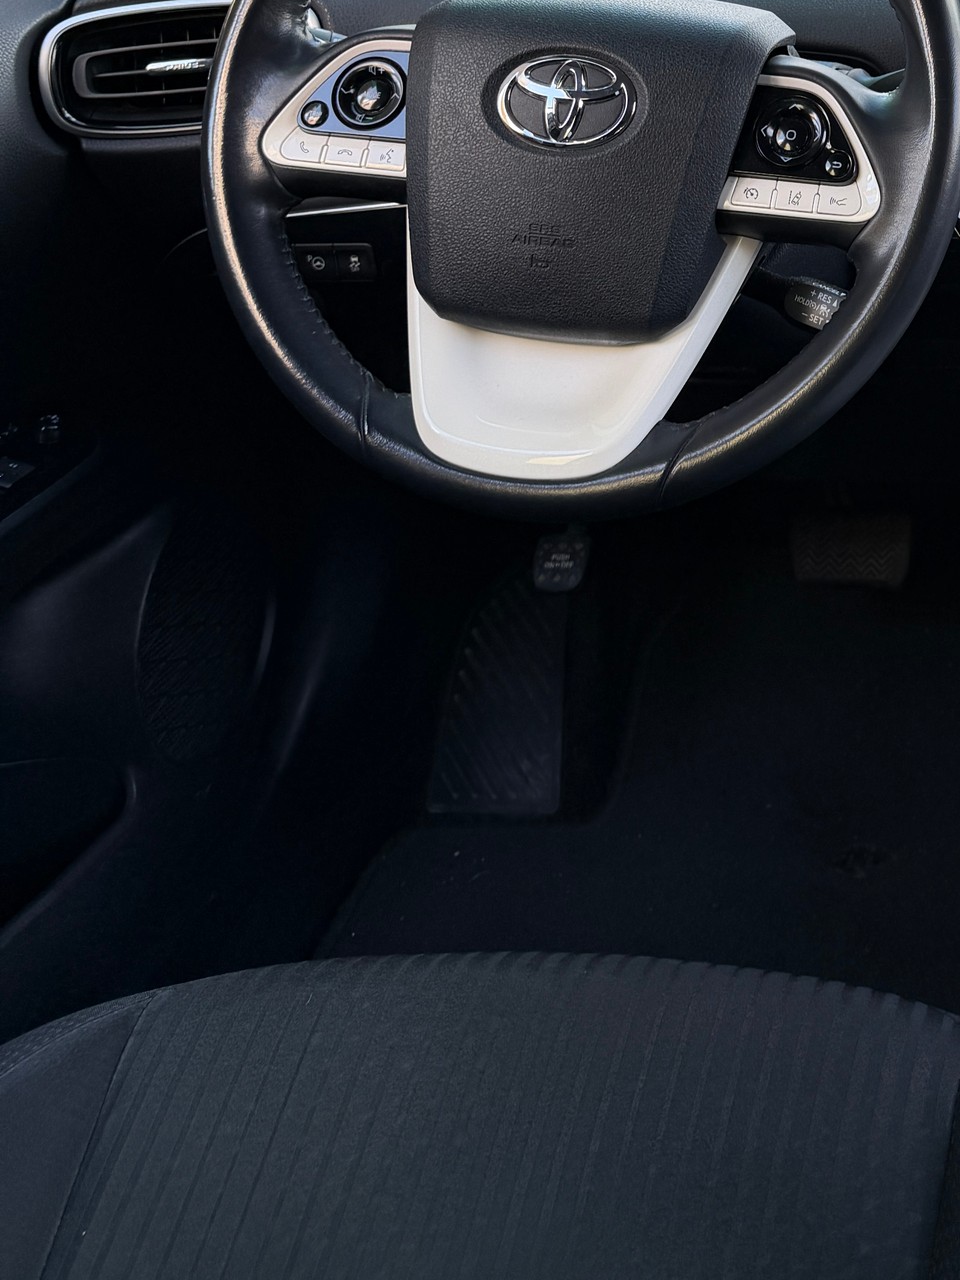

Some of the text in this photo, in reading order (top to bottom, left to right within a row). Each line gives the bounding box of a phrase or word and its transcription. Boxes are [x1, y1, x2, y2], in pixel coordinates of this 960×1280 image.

[794, 294, 811, 308] HOLD
[817, 292, 832, 304] RES
[809, 314, 824, 326] SET
